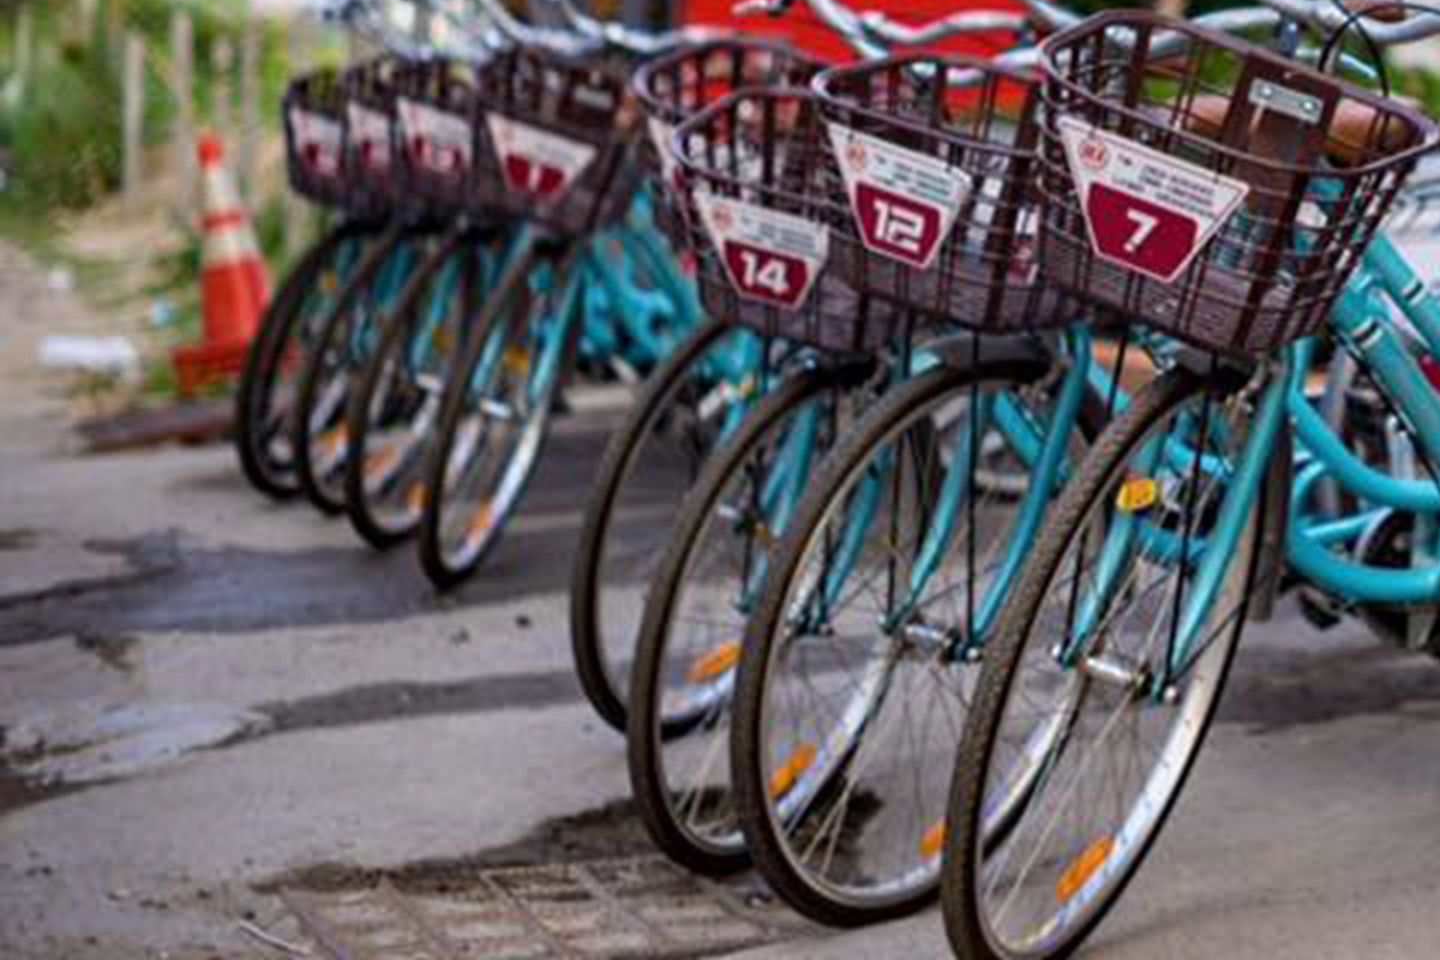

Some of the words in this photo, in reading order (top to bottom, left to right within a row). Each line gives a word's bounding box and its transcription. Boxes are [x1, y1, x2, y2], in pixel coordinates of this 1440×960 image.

[873, 198, 925, 252] 12
[1122, 207, 1159, 253] 7
[740, 250, 789, 294] 14
